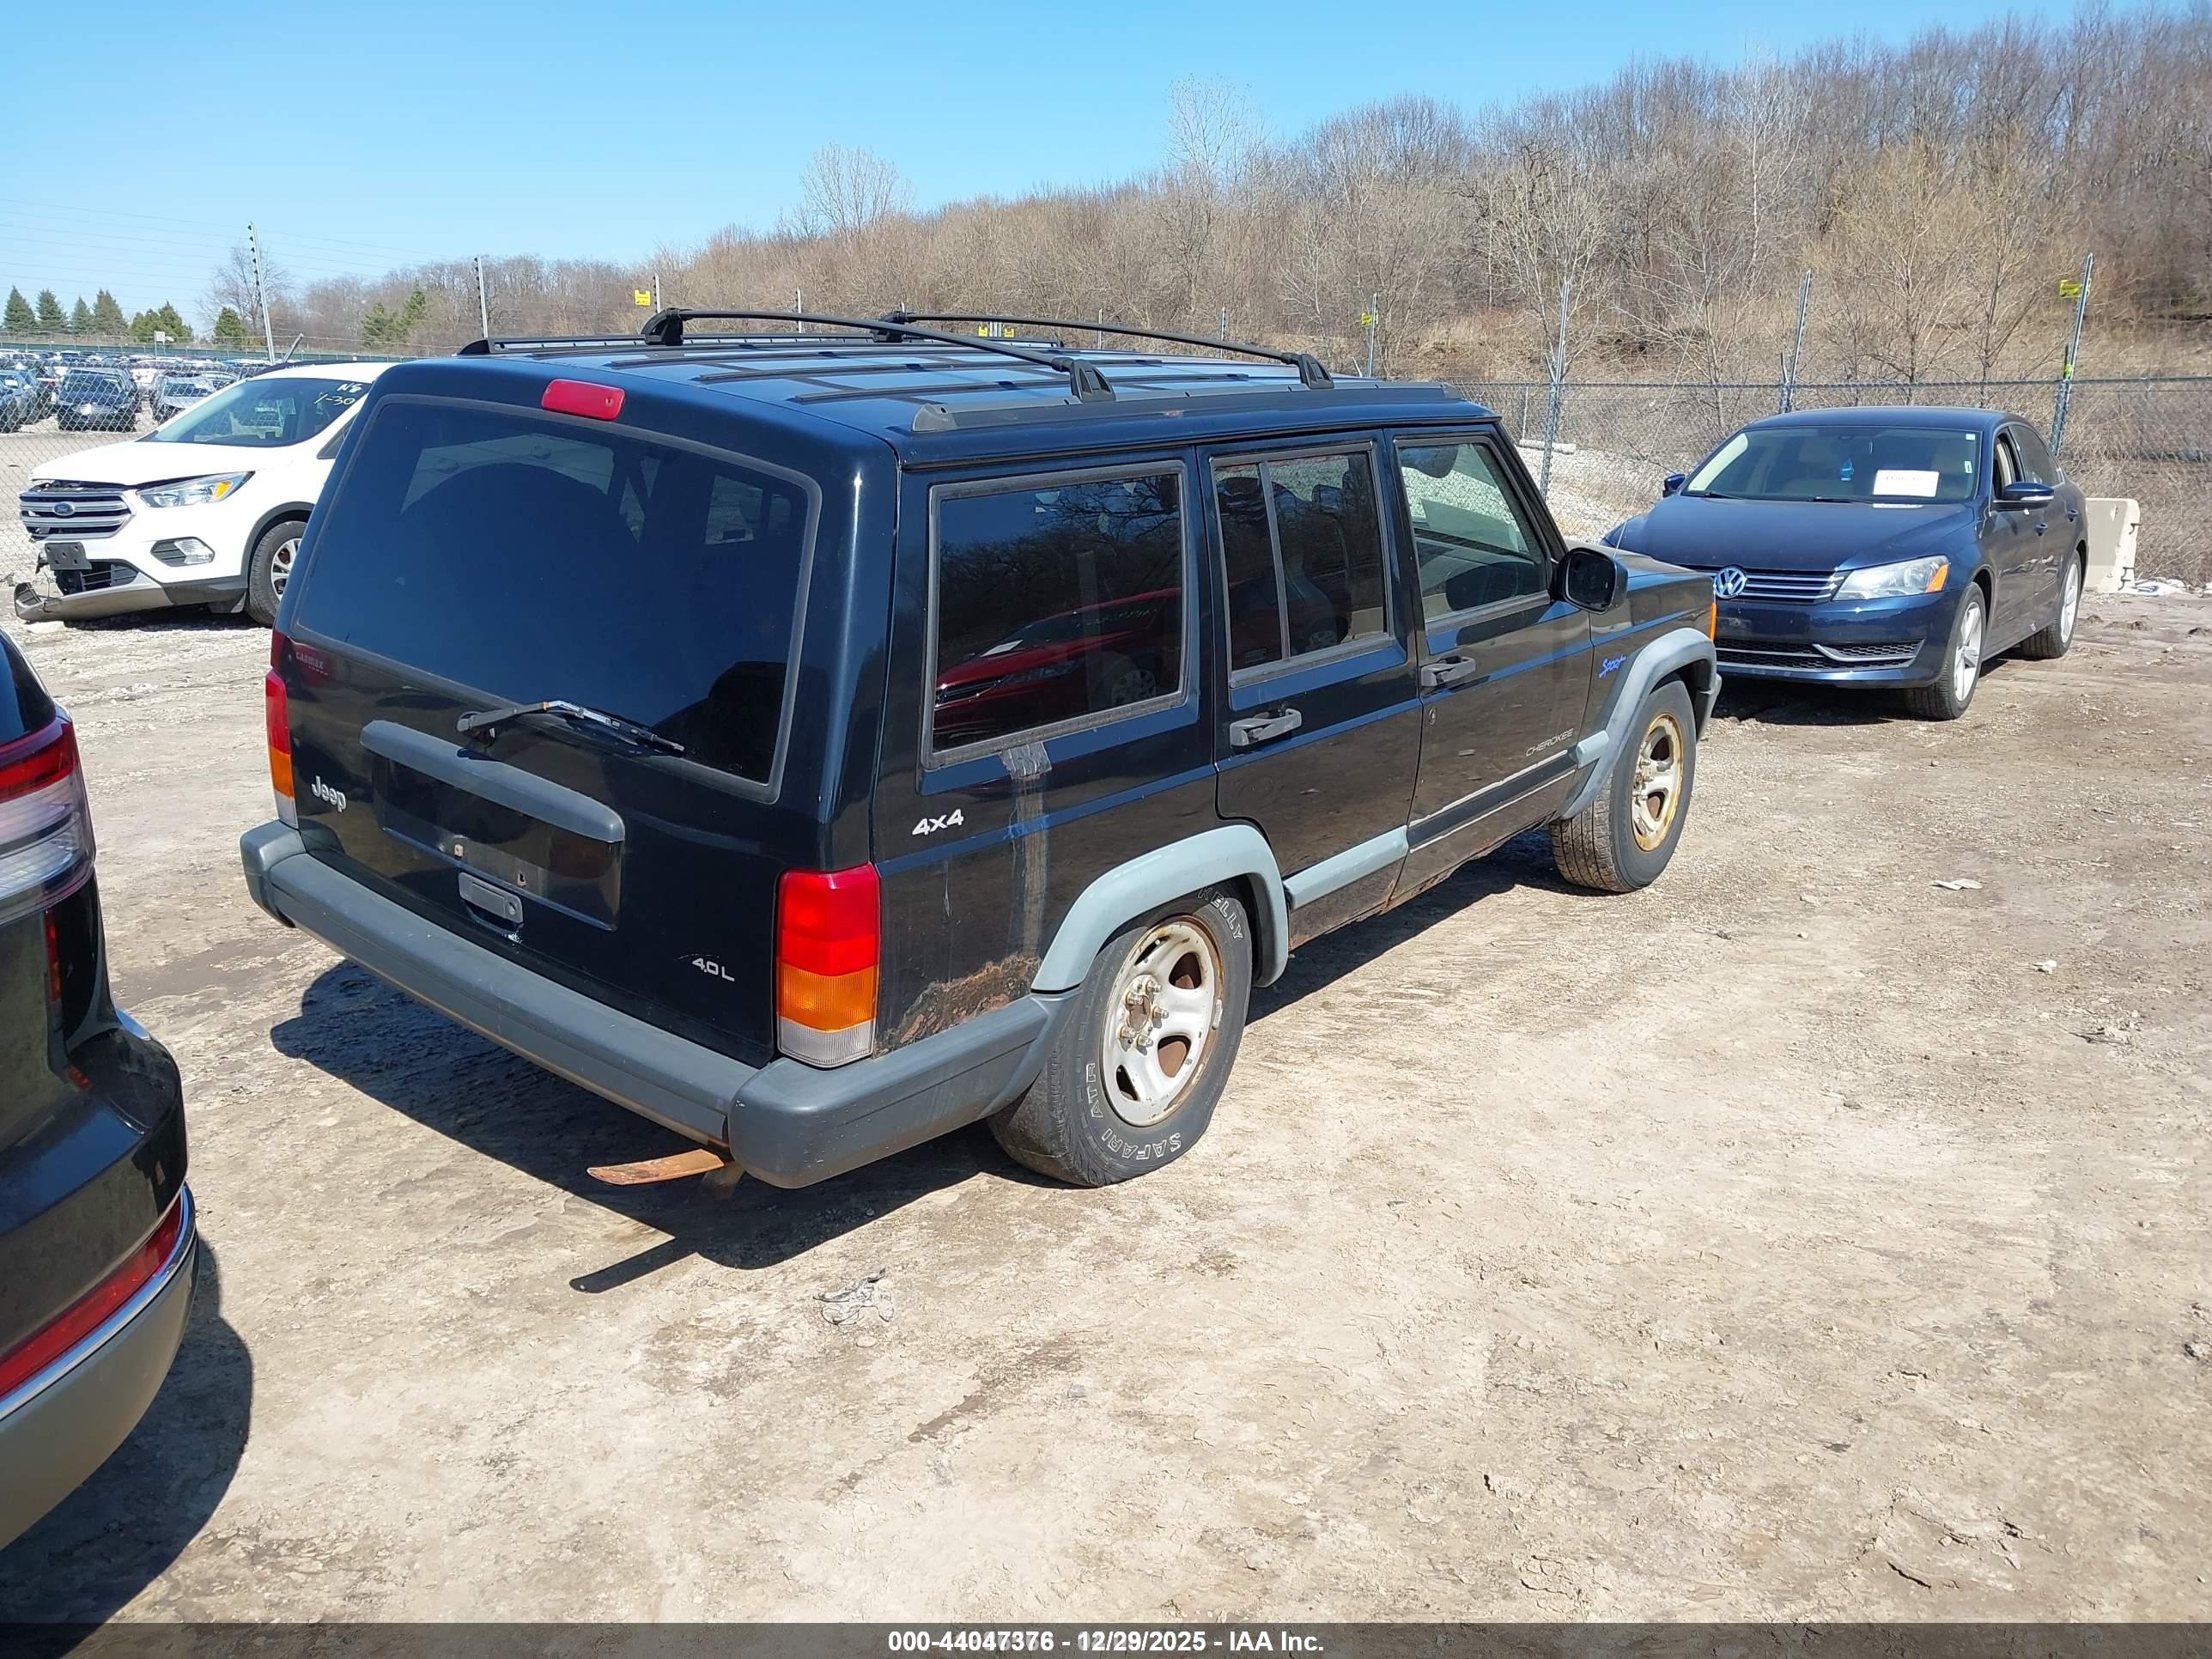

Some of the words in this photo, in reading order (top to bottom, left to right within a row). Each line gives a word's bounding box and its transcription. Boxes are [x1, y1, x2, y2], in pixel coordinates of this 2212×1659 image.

[1525, 728, 1574, 757] CHEROKEE
[310, 775, 347, 812] Jeep
[1197, 887, 1243, 940] KELLY
[1085, 1061, 1103, 1119] ATR
[1101, 1127, 1182, 1161] SAFARI
